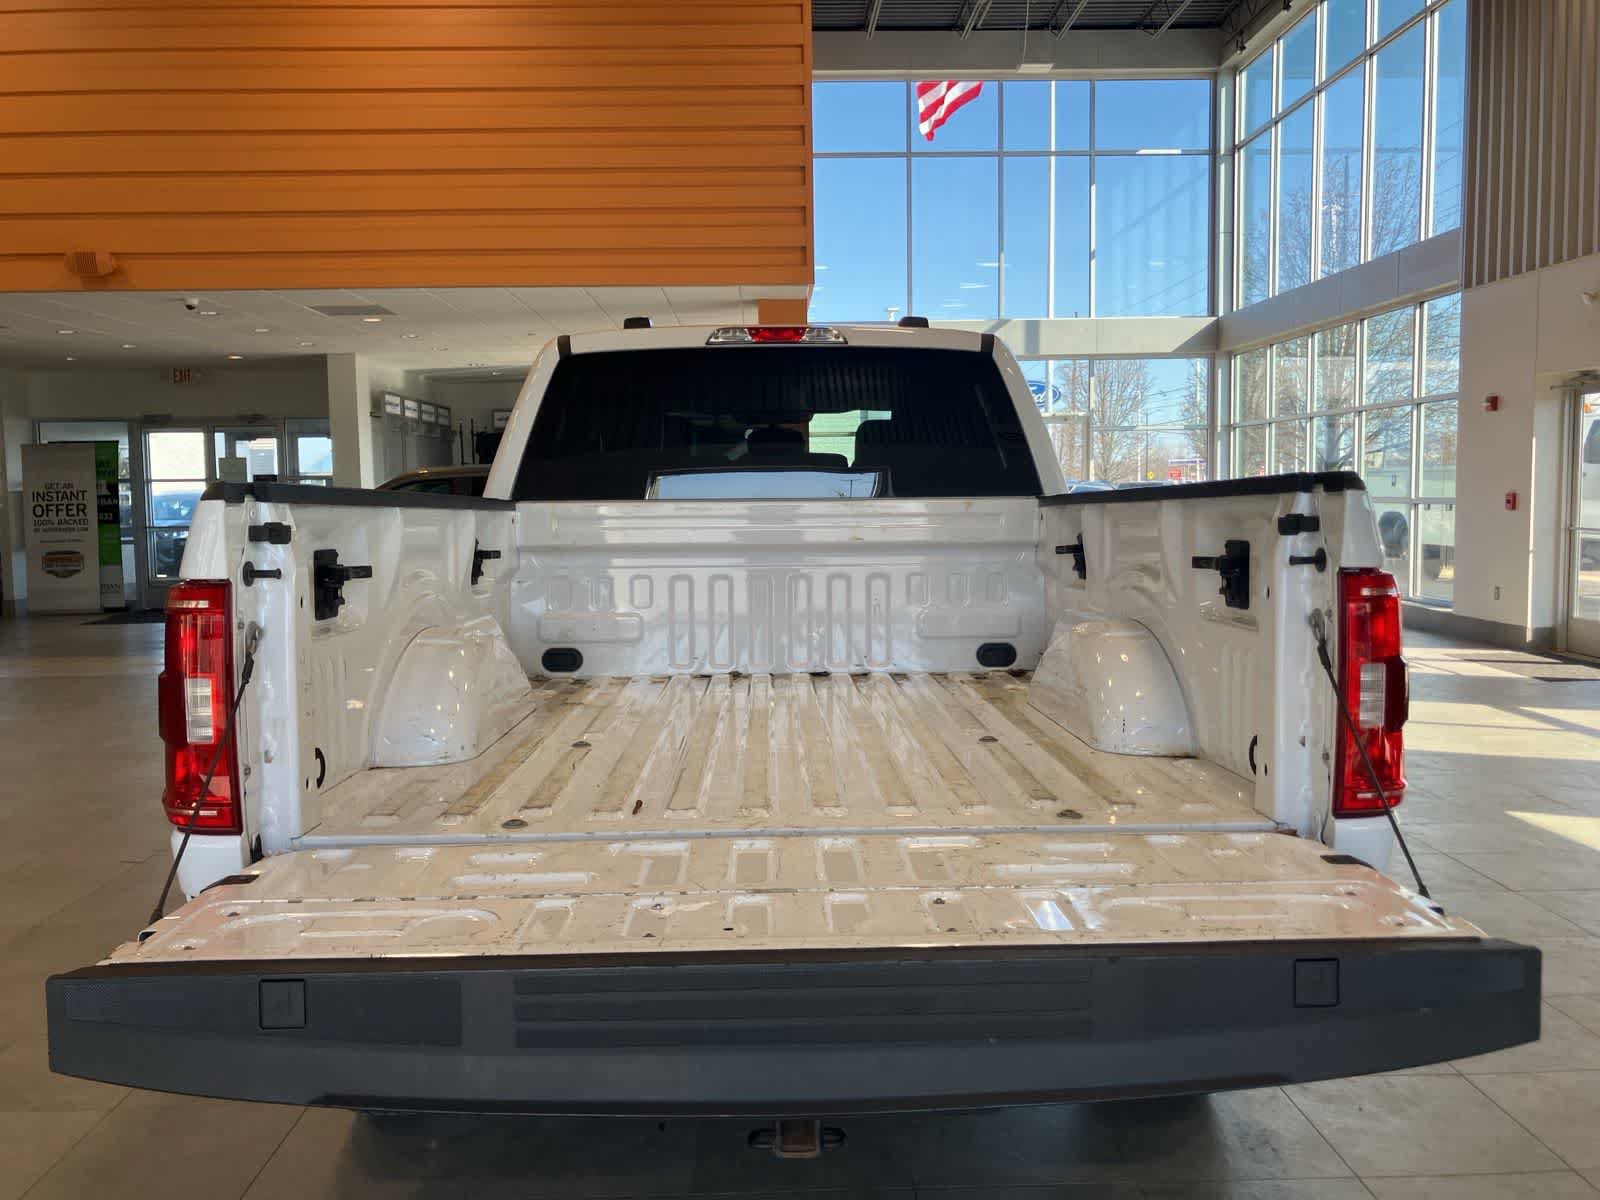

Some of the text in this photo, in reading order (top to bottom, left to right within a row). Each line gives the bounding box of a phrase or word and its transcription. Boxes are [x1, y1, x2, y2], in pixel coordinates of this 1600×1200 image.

[173, 368, 190, 384] EXIT
[32, 490, 87, 502] INSTANT
[32, 503, 88, 518] OFFER
